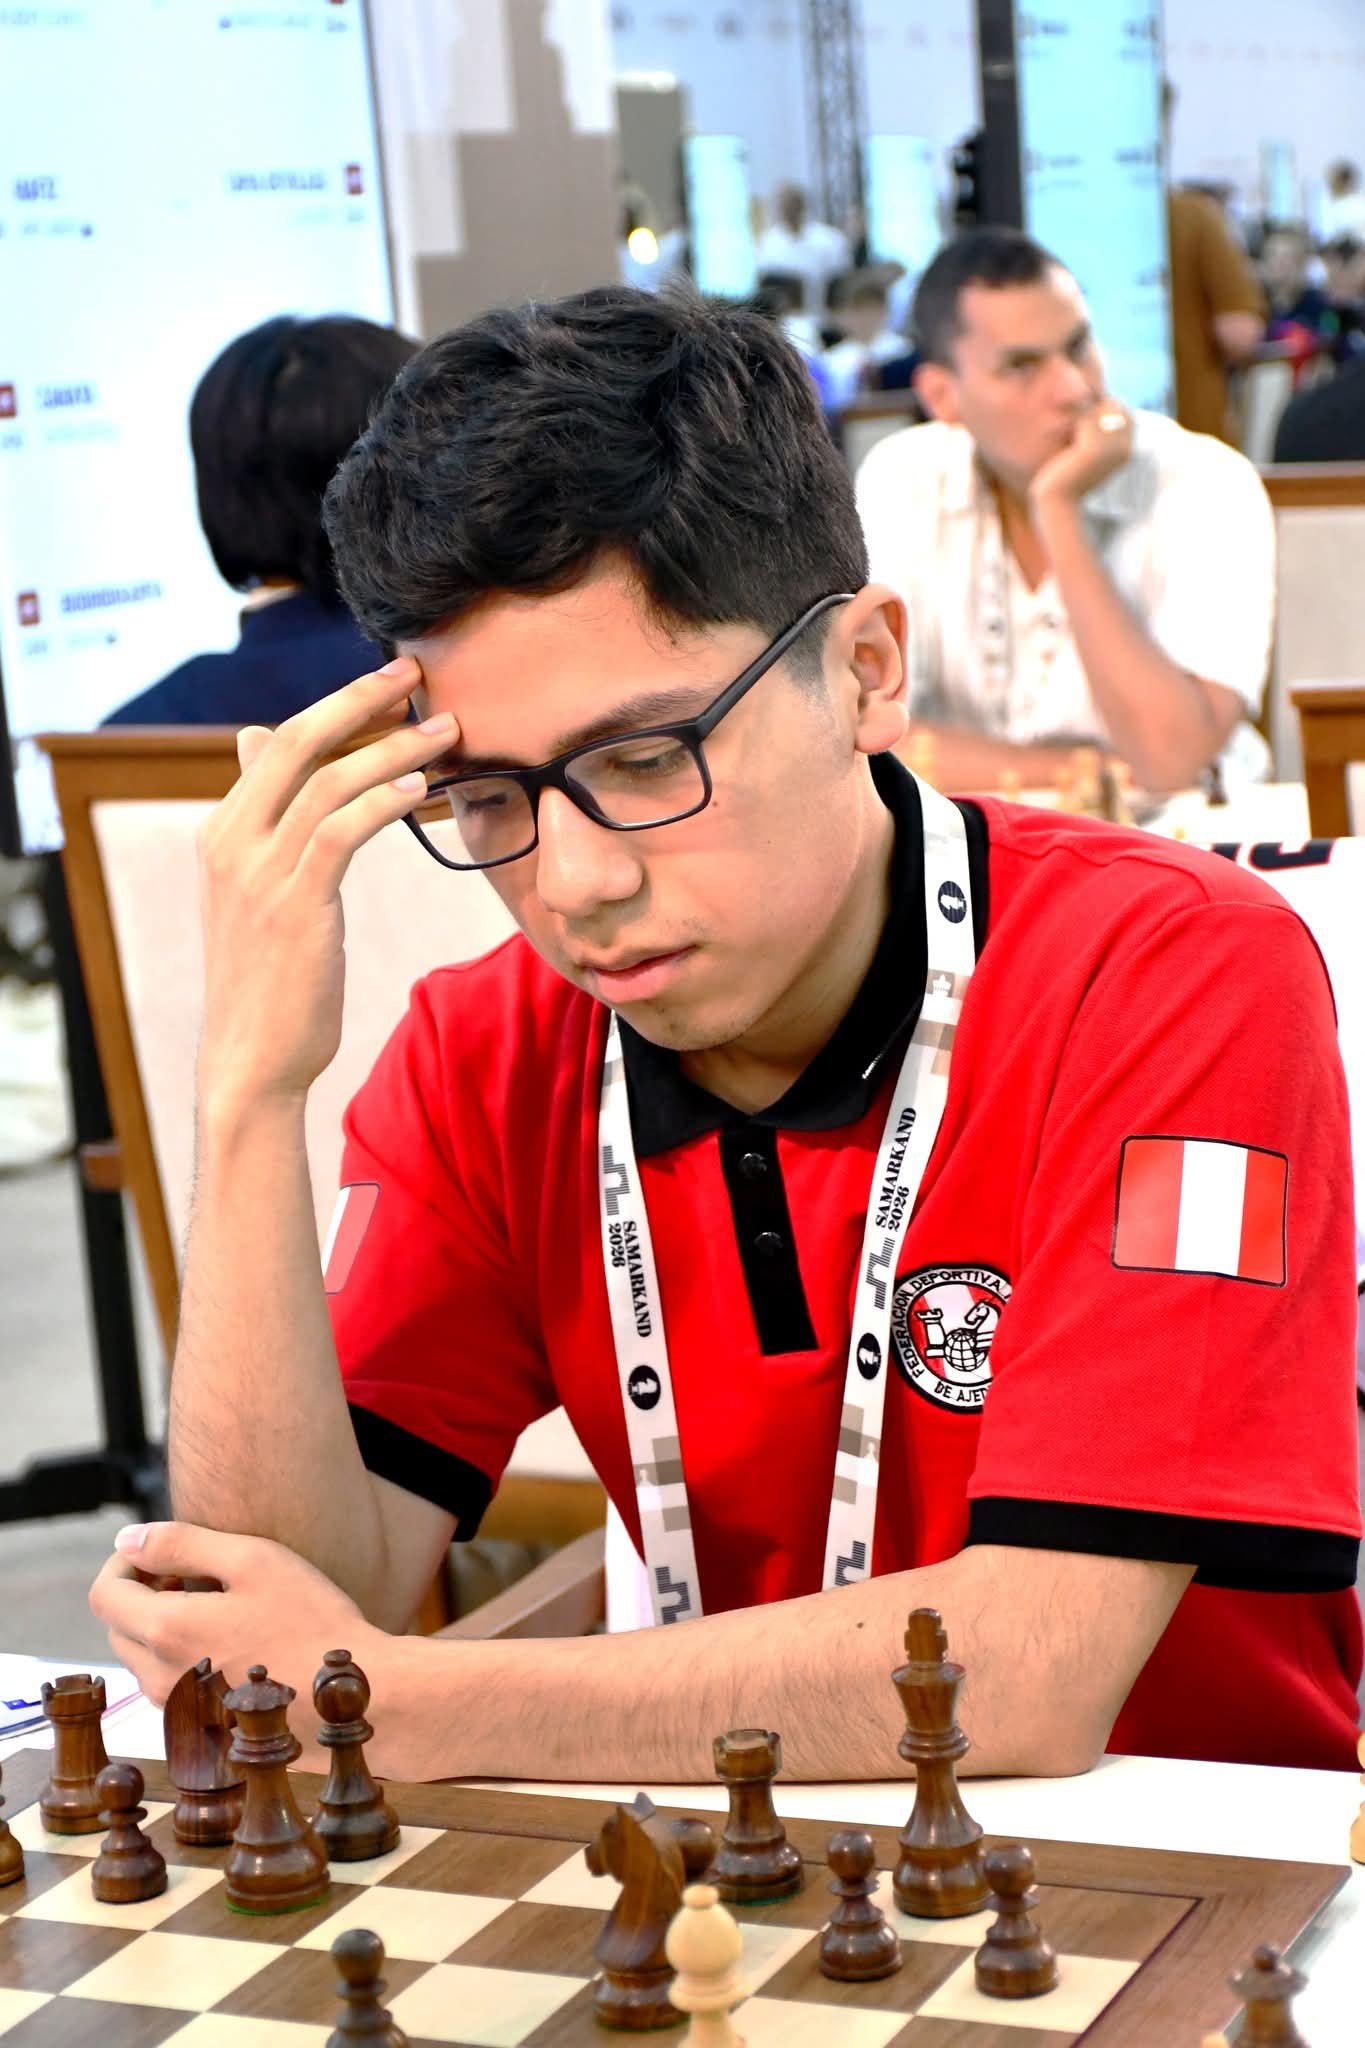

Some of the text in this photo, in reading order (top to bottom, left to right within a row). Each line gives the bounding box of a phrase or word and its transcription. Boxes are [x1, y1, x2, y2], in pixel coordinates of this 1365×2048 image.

[875, 1107, 917, 1228] SAMARKAND
[887, 1185, 910, 1232] 2026
[608, 1222, 626, 1268] 2026
[623, 1220, 652, 1338] SAMARKAND
[910, 1270, 1001, 1292] DEPORTIVA
[934, 1380, 953, 1398] DE
